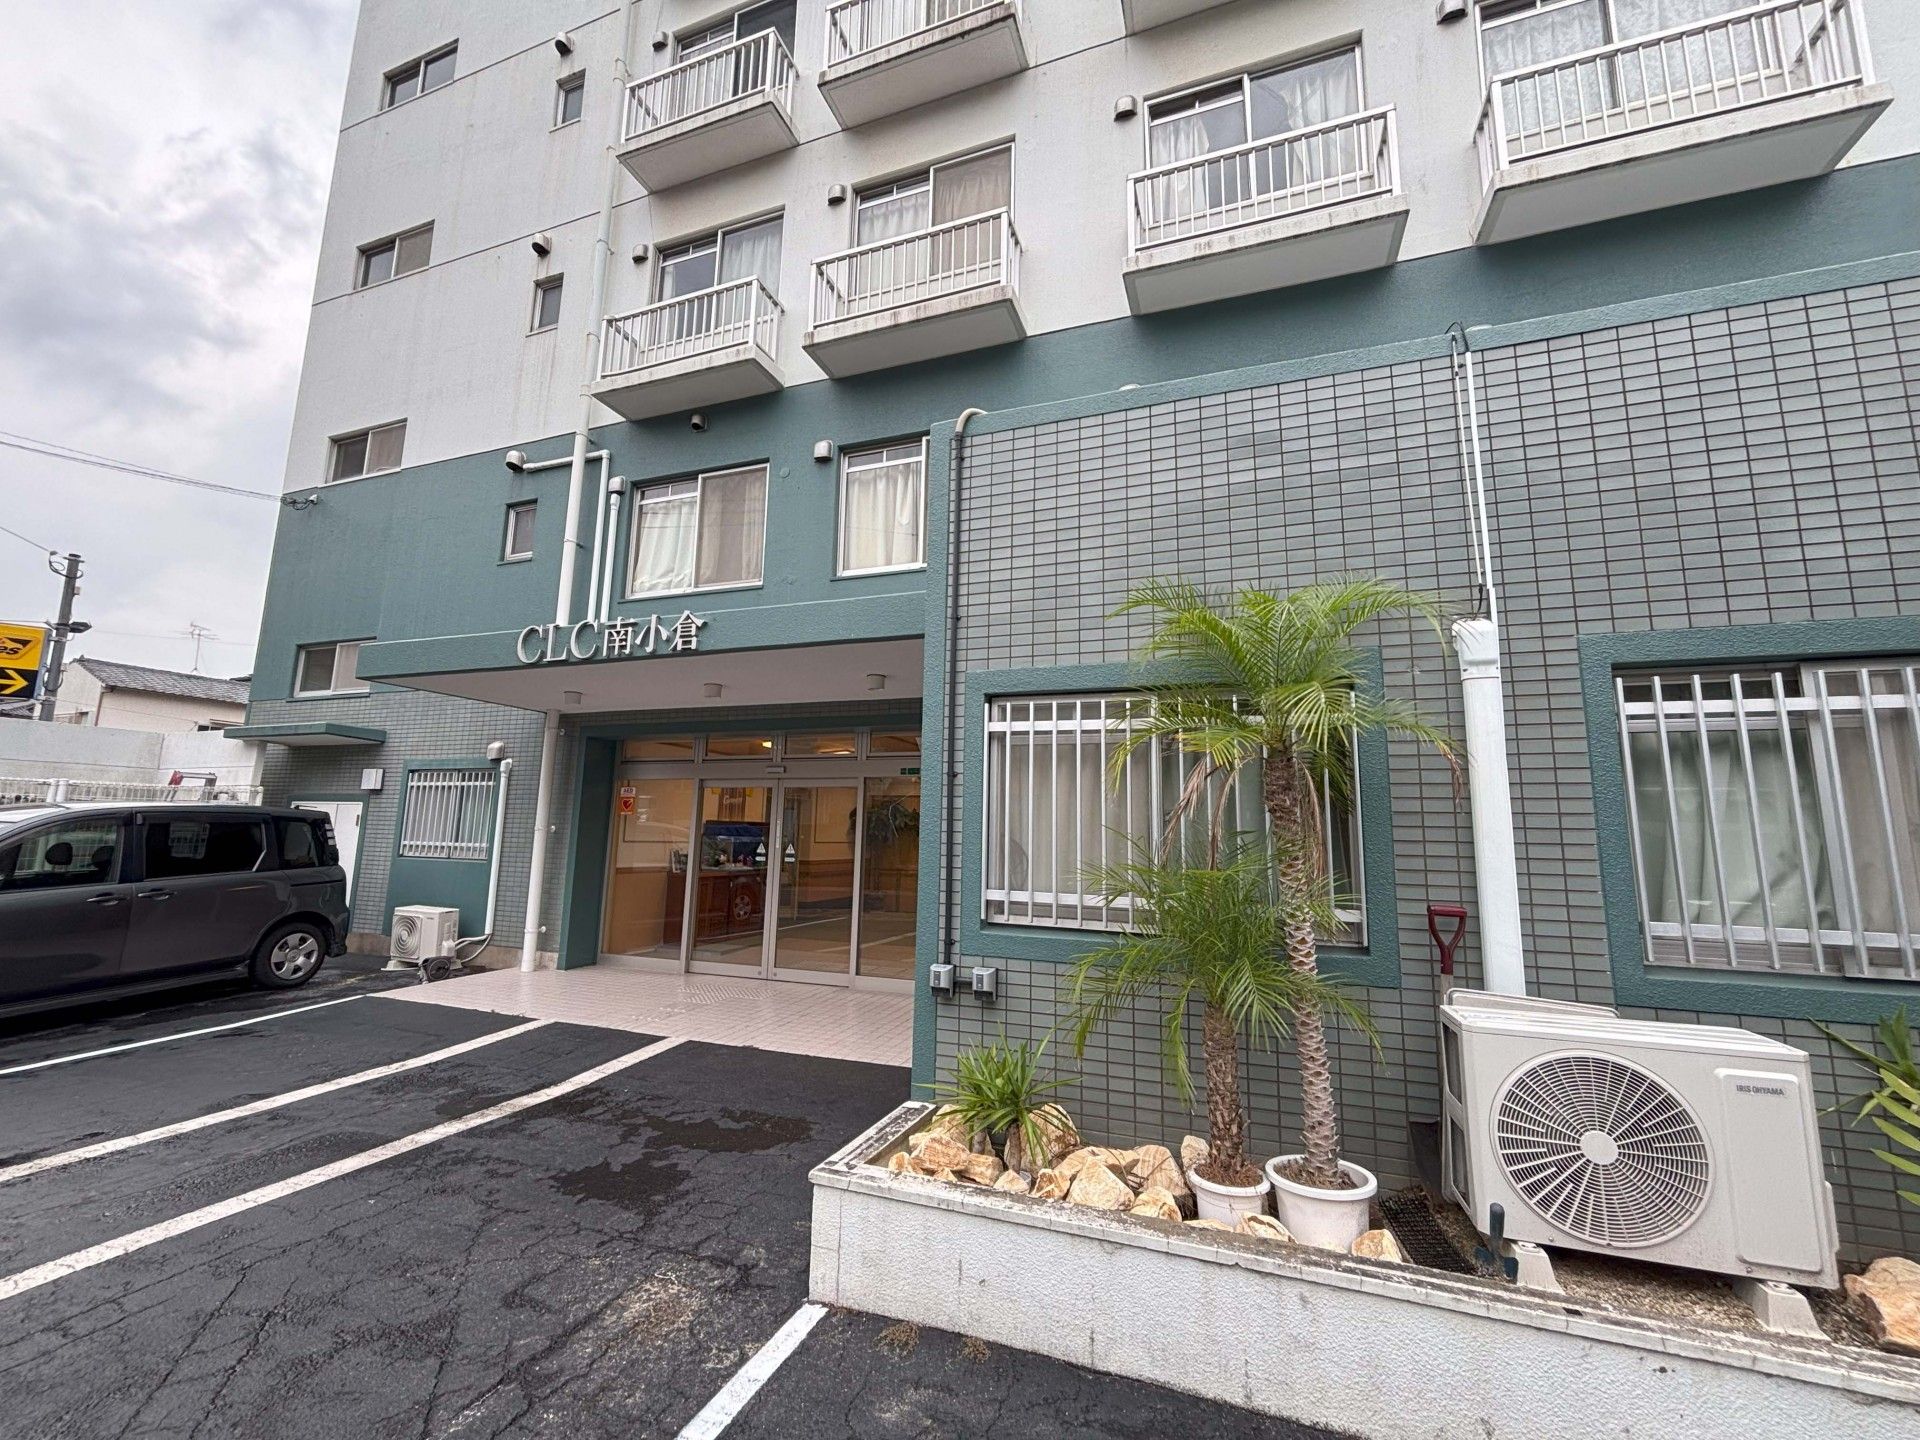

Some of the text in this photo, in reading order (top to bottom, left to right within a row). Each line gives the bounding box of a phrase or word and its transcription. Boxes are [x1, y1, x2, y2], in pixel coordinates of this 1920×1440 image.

[516, 609, 706, 664] CLC南小倉
[1736, 1084, 1785, 1096] IRIS OHYAMA
